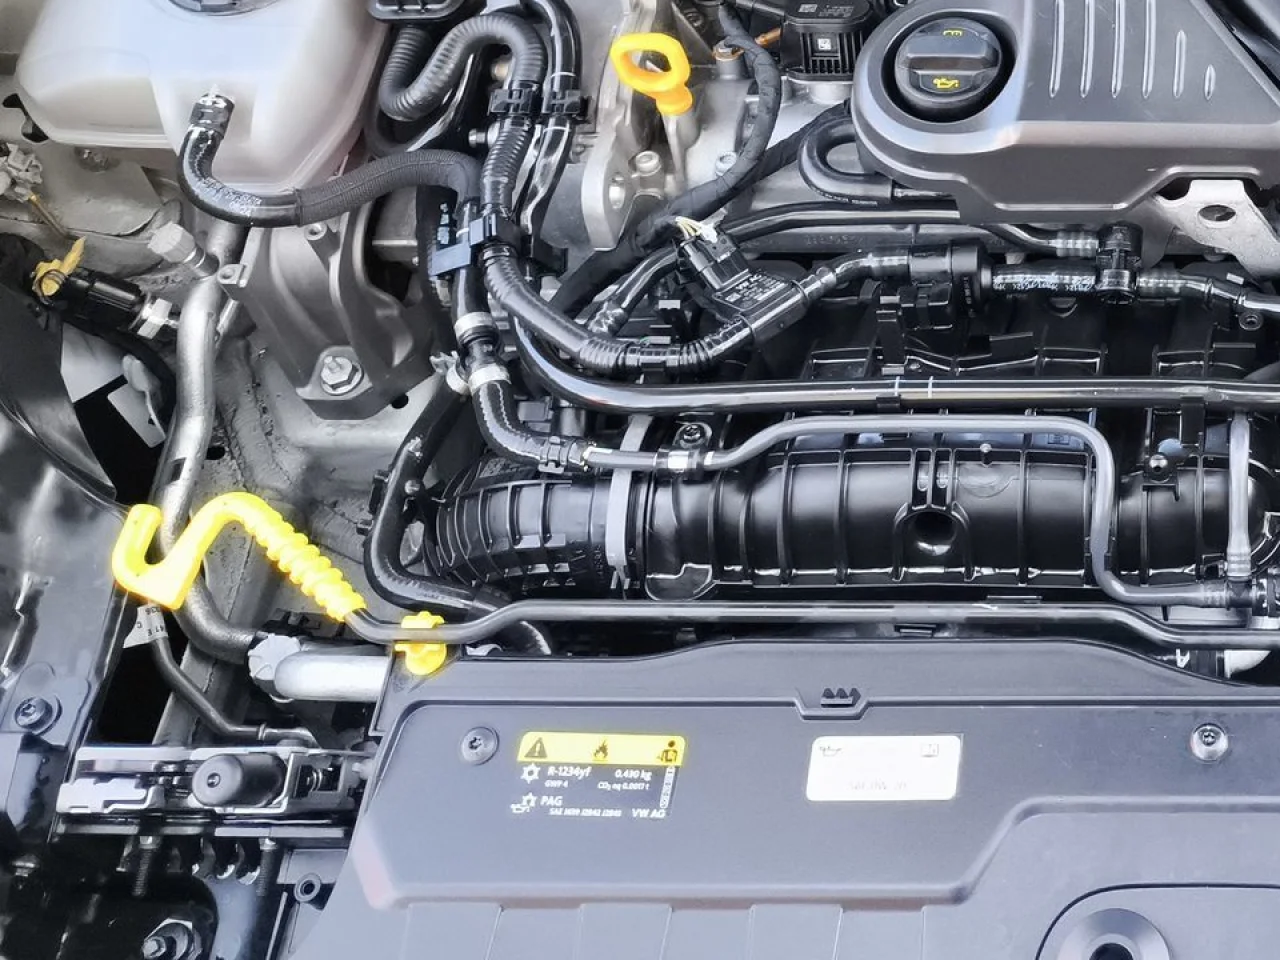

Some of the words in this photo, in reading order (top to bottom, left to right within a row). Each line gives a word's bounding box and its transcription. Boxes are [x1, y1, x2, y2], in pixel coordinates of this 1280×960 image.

[547, 766, 592, 779] R-1234yf
[640, 770, 653, 781] kg
[544, 780, 562, 788] GWP
[540, 796, 563, 807] PAG
[632, 808, 649, 817] VW
[650, 809, 666, 818] AG
